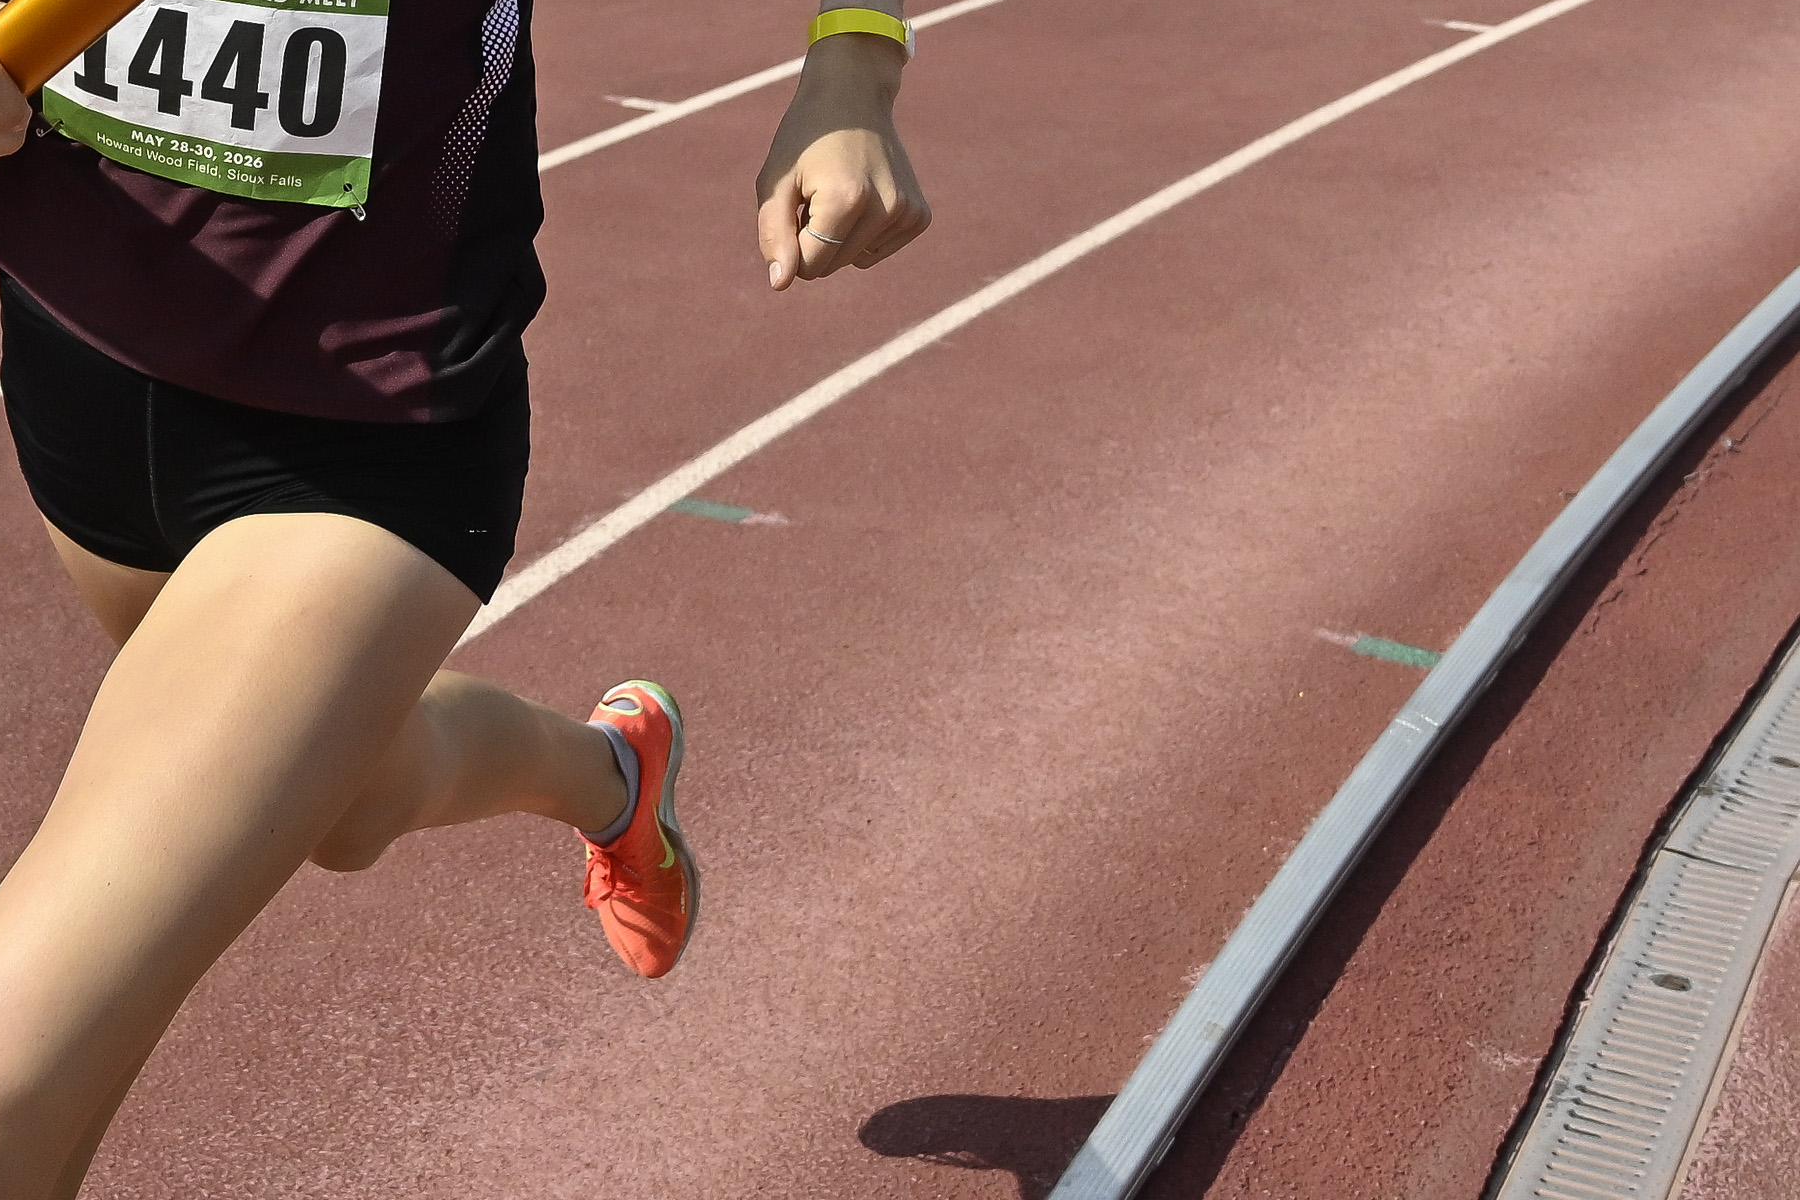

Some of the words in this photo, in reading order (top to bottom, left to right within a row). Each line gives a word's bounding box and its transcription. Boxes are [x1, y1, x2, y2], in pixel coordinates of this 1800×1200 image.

[96, 132, 142, 157] Howard
[146, 148, 183, 168] Wood
[187, 158, 222, 179] Field,
[226, 168, 265, 185] Sioux
[269, 174, 303, 188] Falls
[131, 130, 165, 148] MAY
[170, 139, 218, 162] 28-30,
[223, 151, 263, 169] 2026
